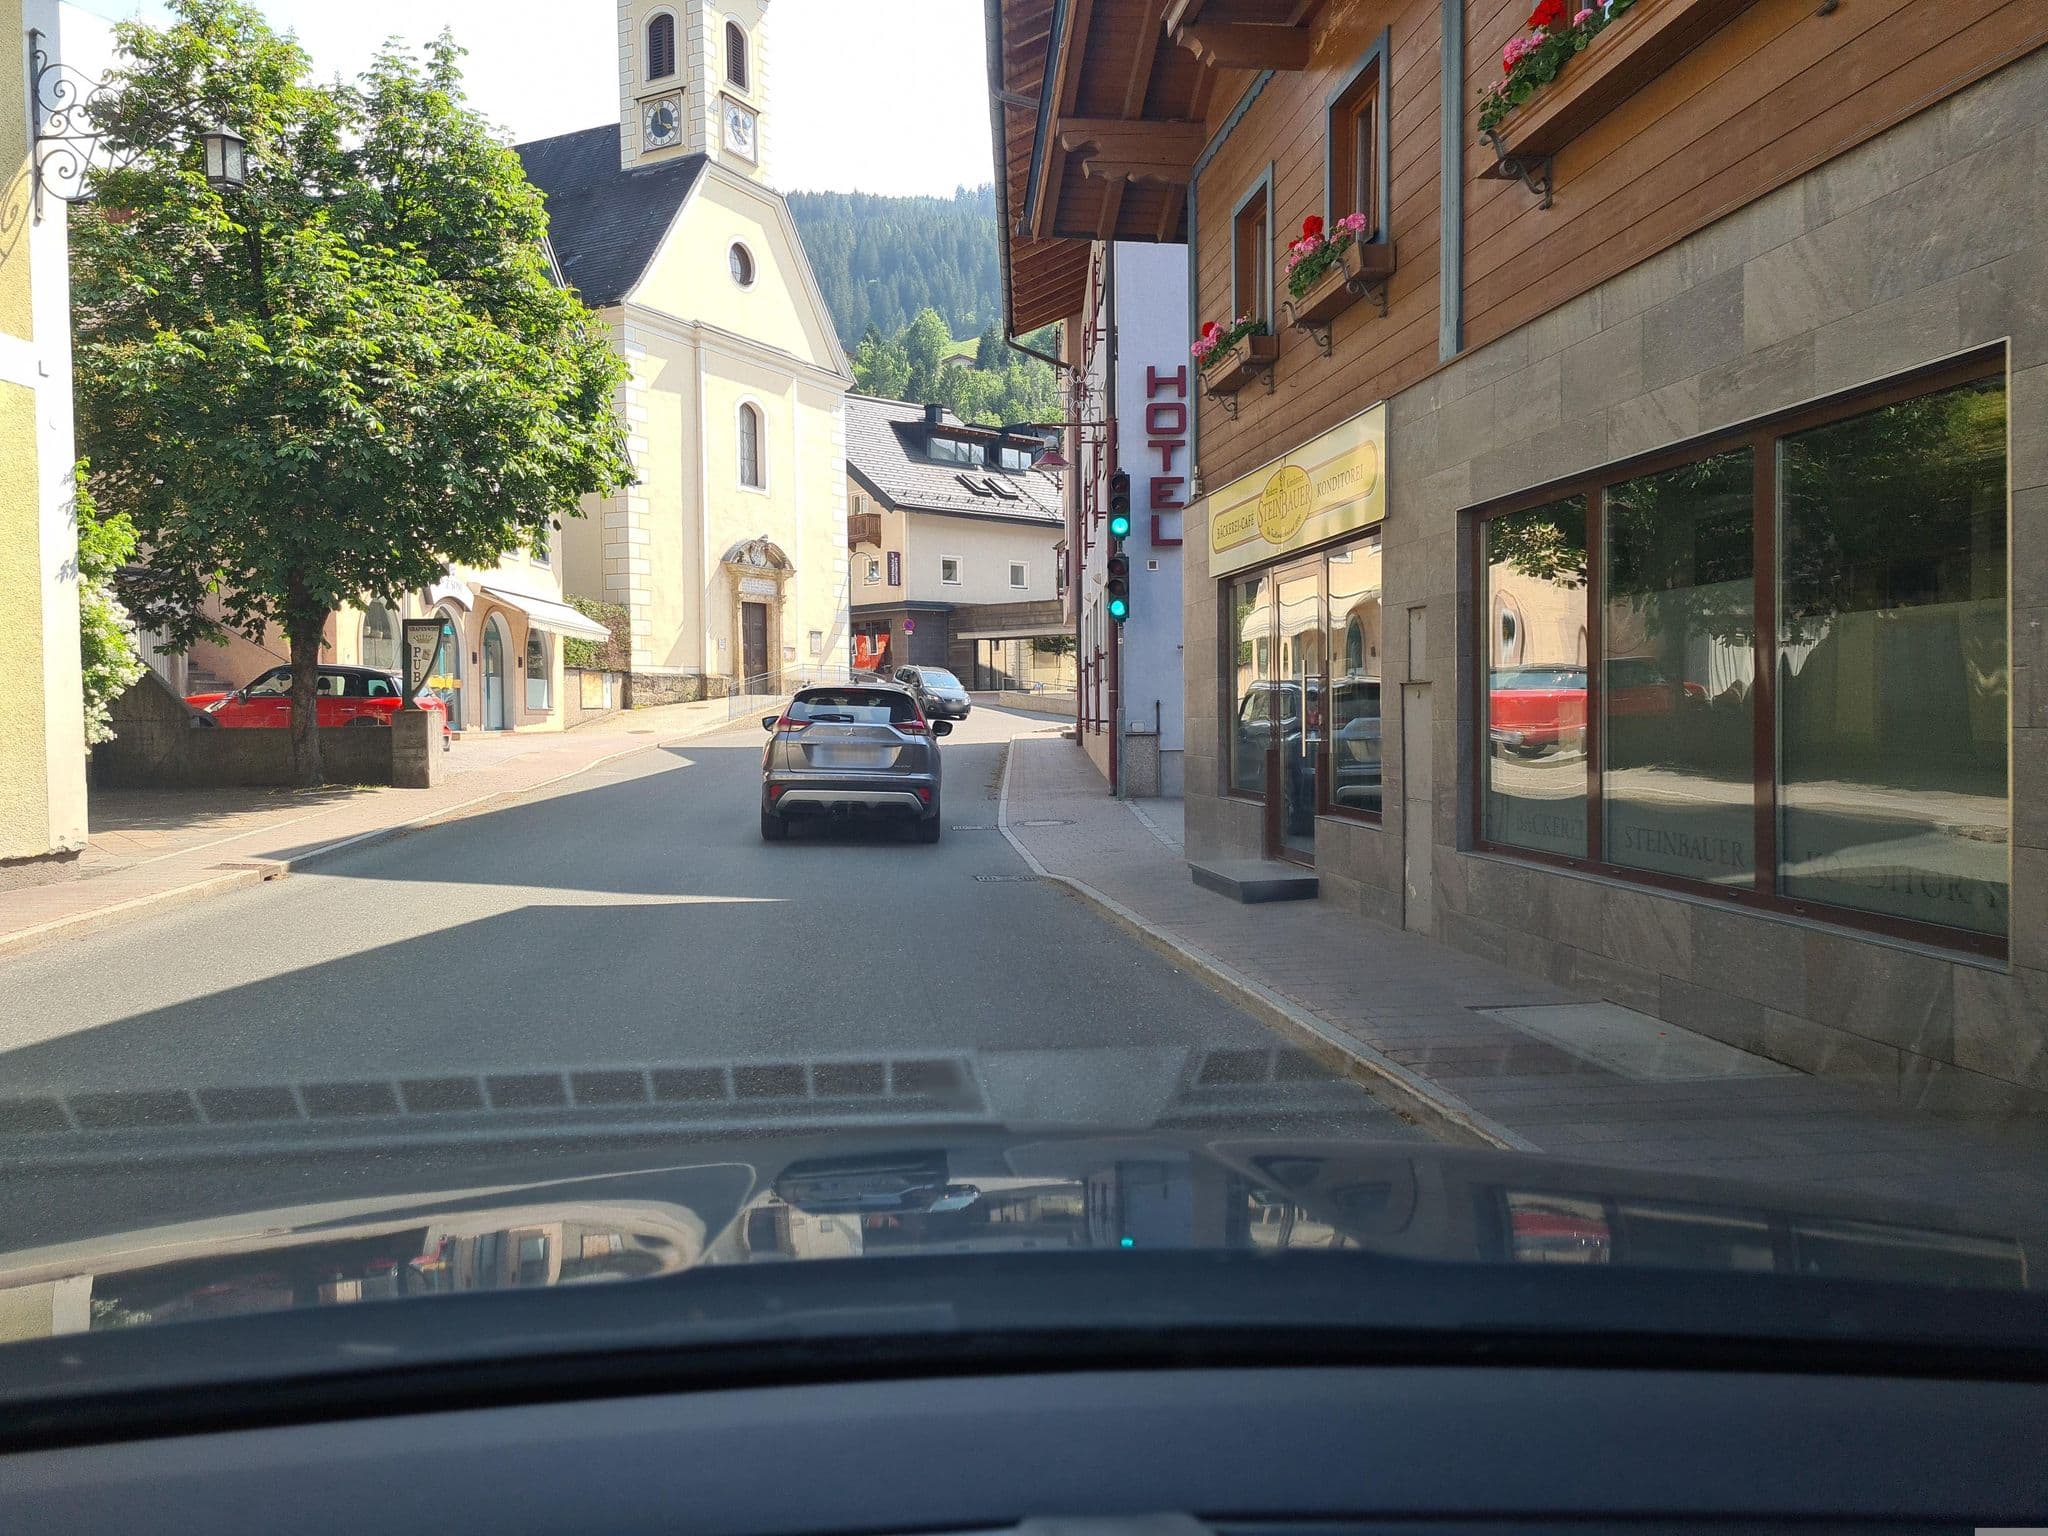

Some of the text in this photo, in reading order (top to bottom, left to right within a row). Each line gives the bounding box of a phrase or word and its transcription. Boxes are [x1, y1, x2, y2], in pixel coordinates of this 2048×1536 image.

[1146, 365, 1187, 546] HOTEL
[1316, 464, 1363, 497] KONDITOREI
[413, 646, 421, 683] PUB
[1624, 825, 1747, 868] STEINBAUER
